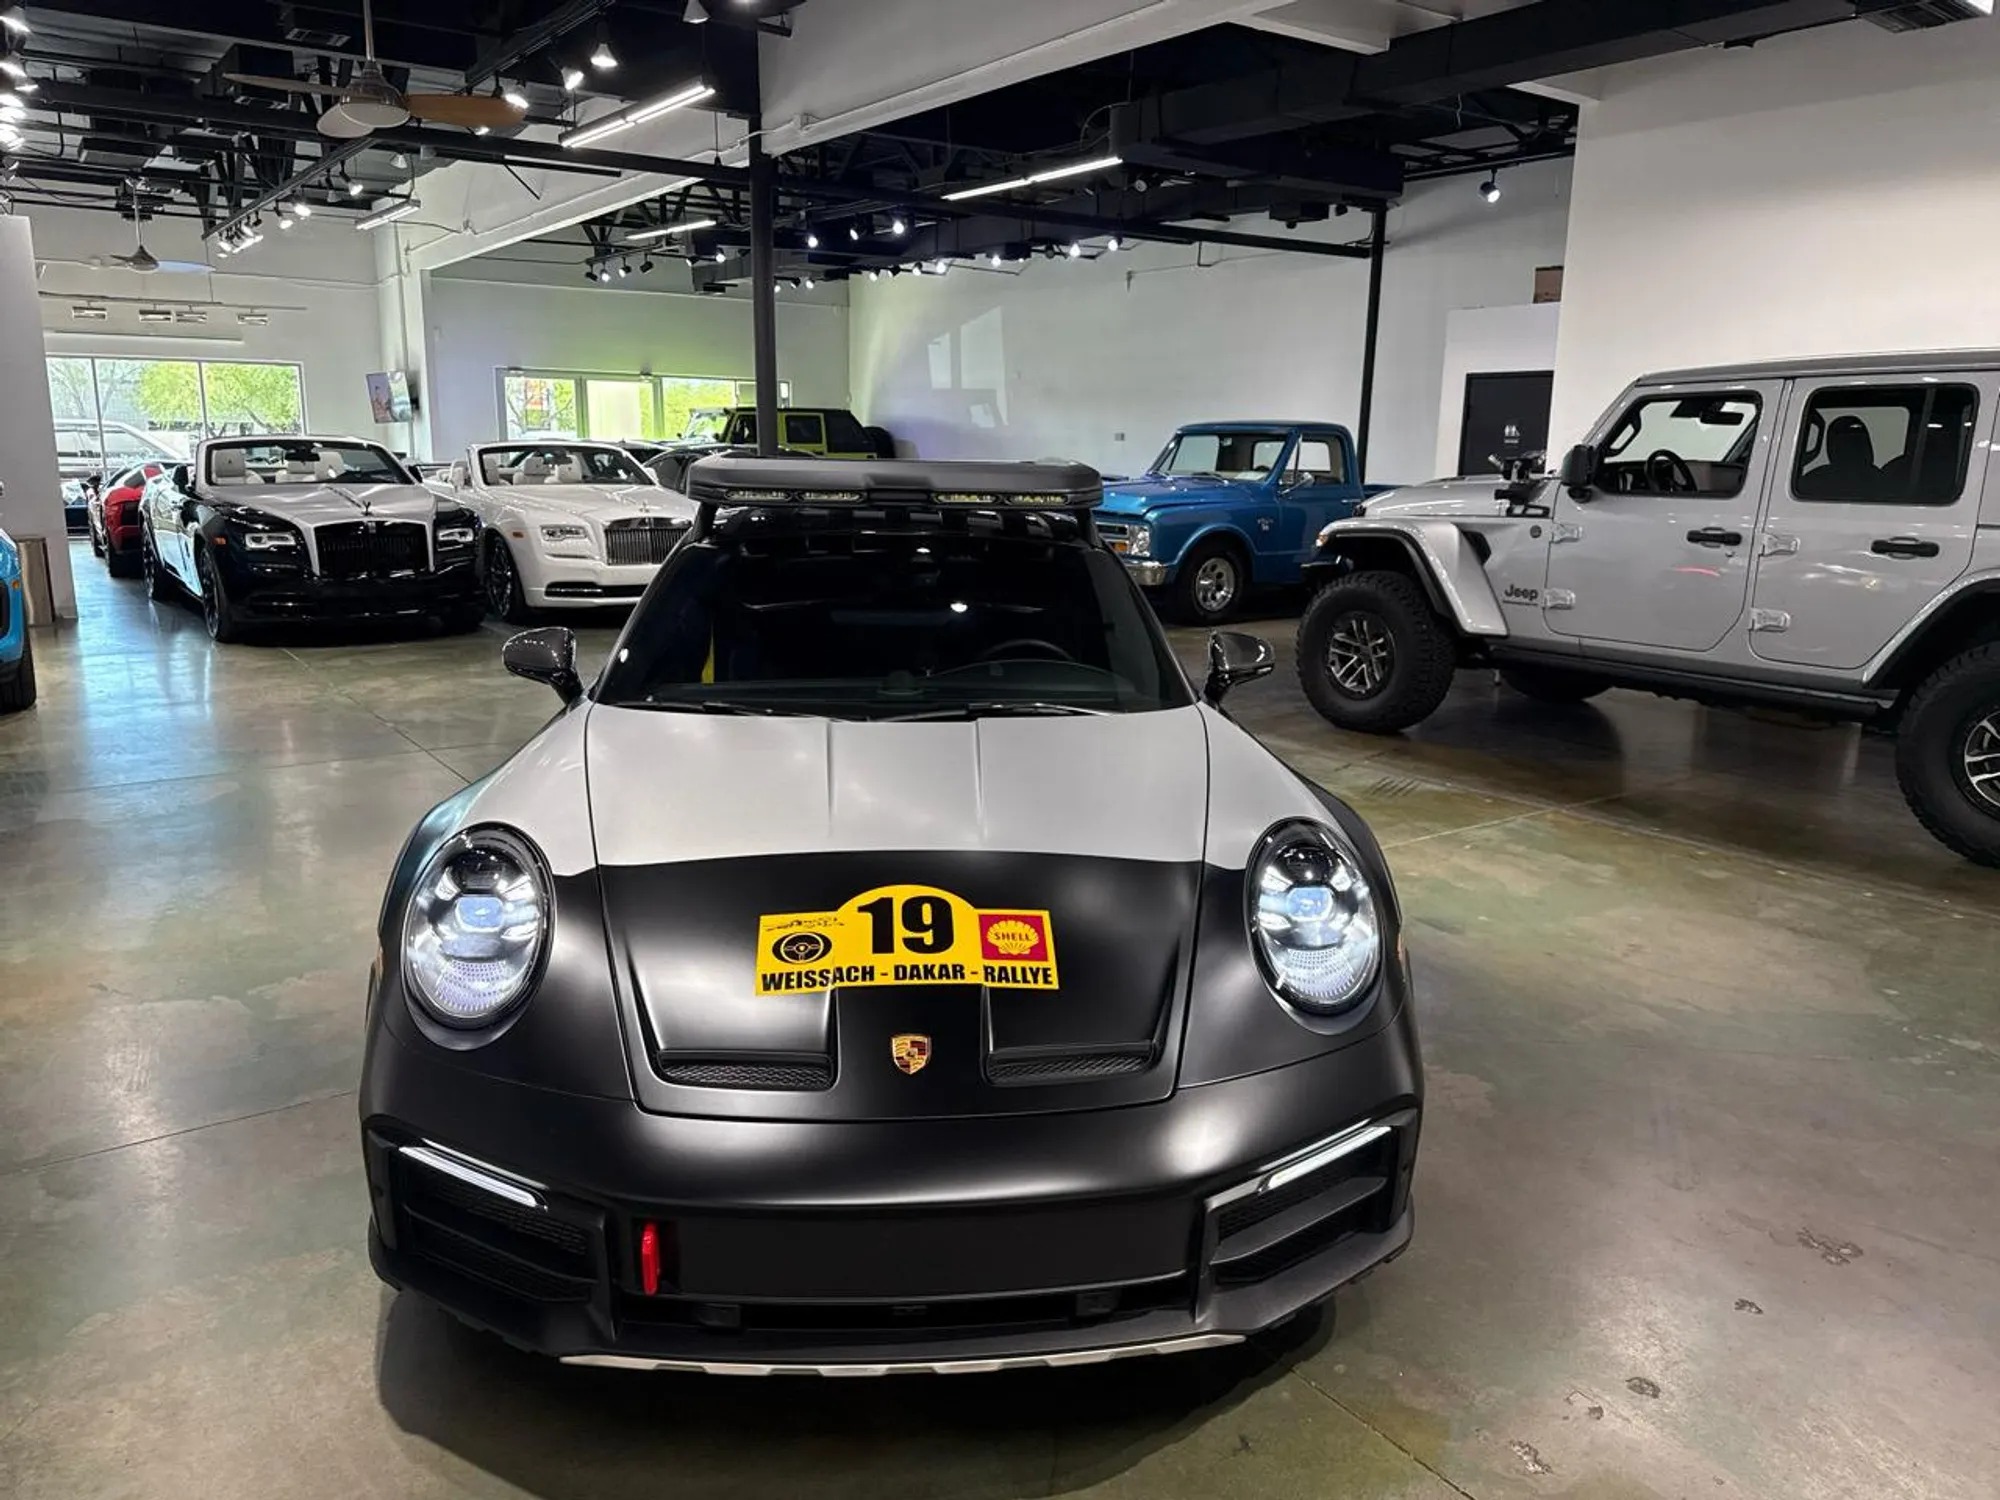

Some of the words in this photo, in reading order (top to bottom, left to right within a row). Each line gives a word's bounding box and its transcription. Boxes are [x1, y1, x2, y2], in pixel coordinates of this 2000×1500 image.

[1504, 584, 1538, 601] Jeep
[857, 895, 954, 954] 19
[994, 931, 1032, 942] SHELL
[761, 965, 875, 992] WEISSACH
[893, 963, 965, 982] DAKAR
[983, 964, 1053, 985] RALLYE
